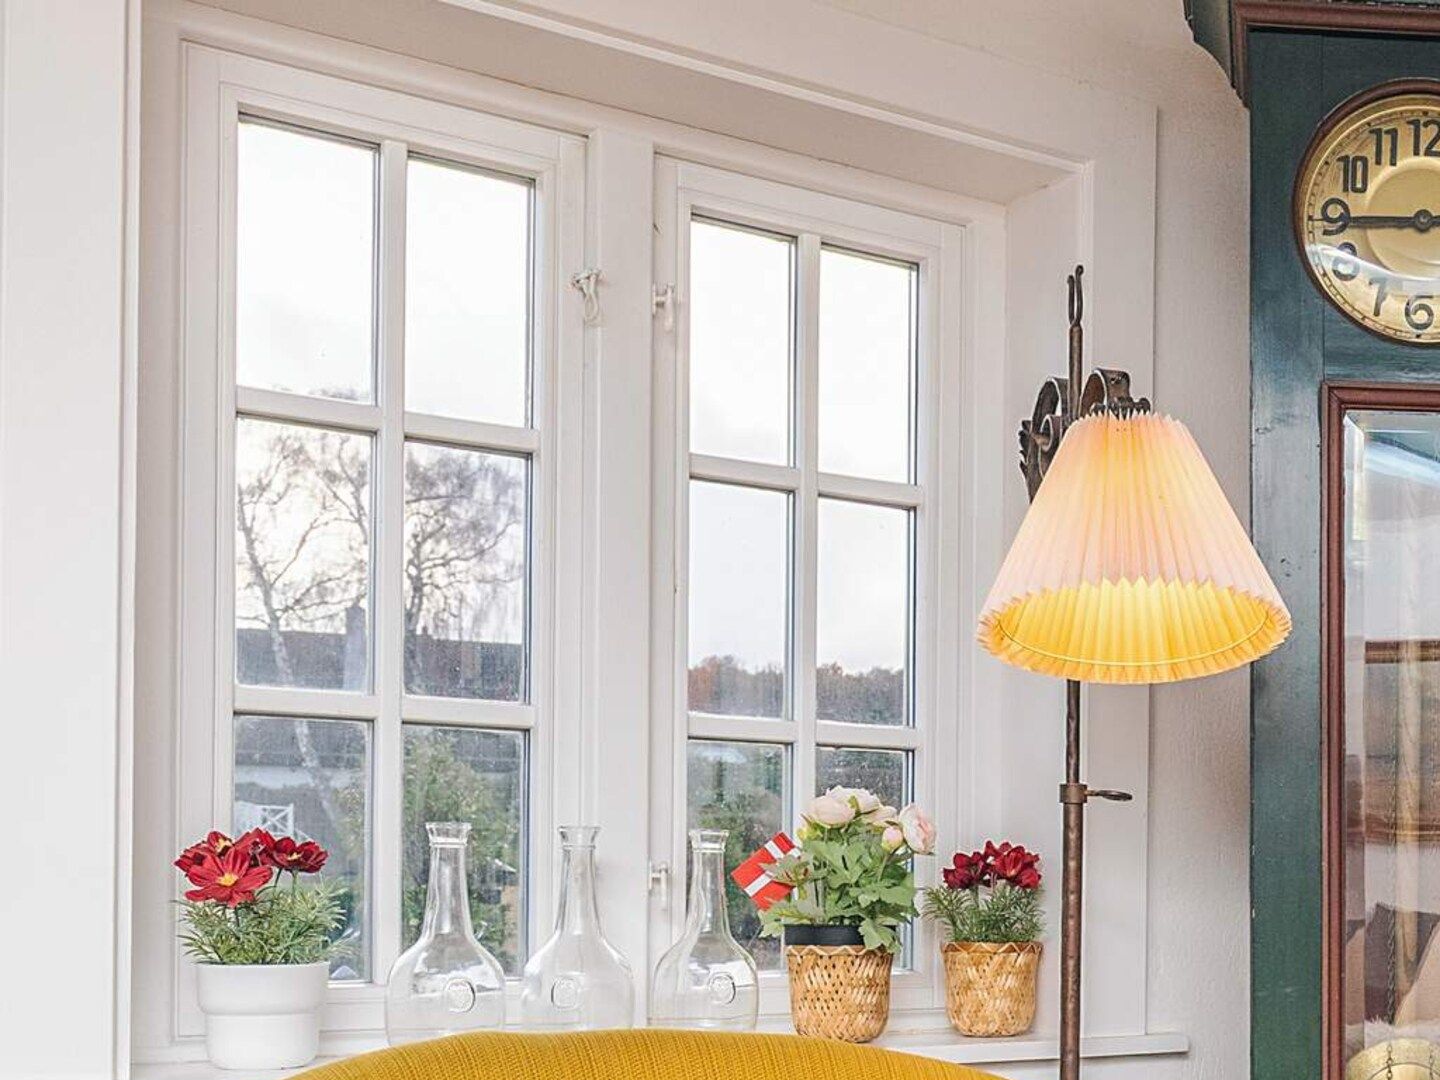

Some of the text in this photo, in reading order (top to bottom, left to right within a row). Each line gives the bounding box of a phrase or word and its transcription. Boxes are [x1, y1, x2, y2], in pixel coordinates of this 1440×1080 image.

[1368, 127, 1399, 167] 11
[1336, 155, 1369, 193] 10
[1320, 197, 1350, 236] 9
[1331, 241, 1360, 282] 8
[1368, 277, 1389, 317] 7
[1404, 294, 1435, 331] 6
